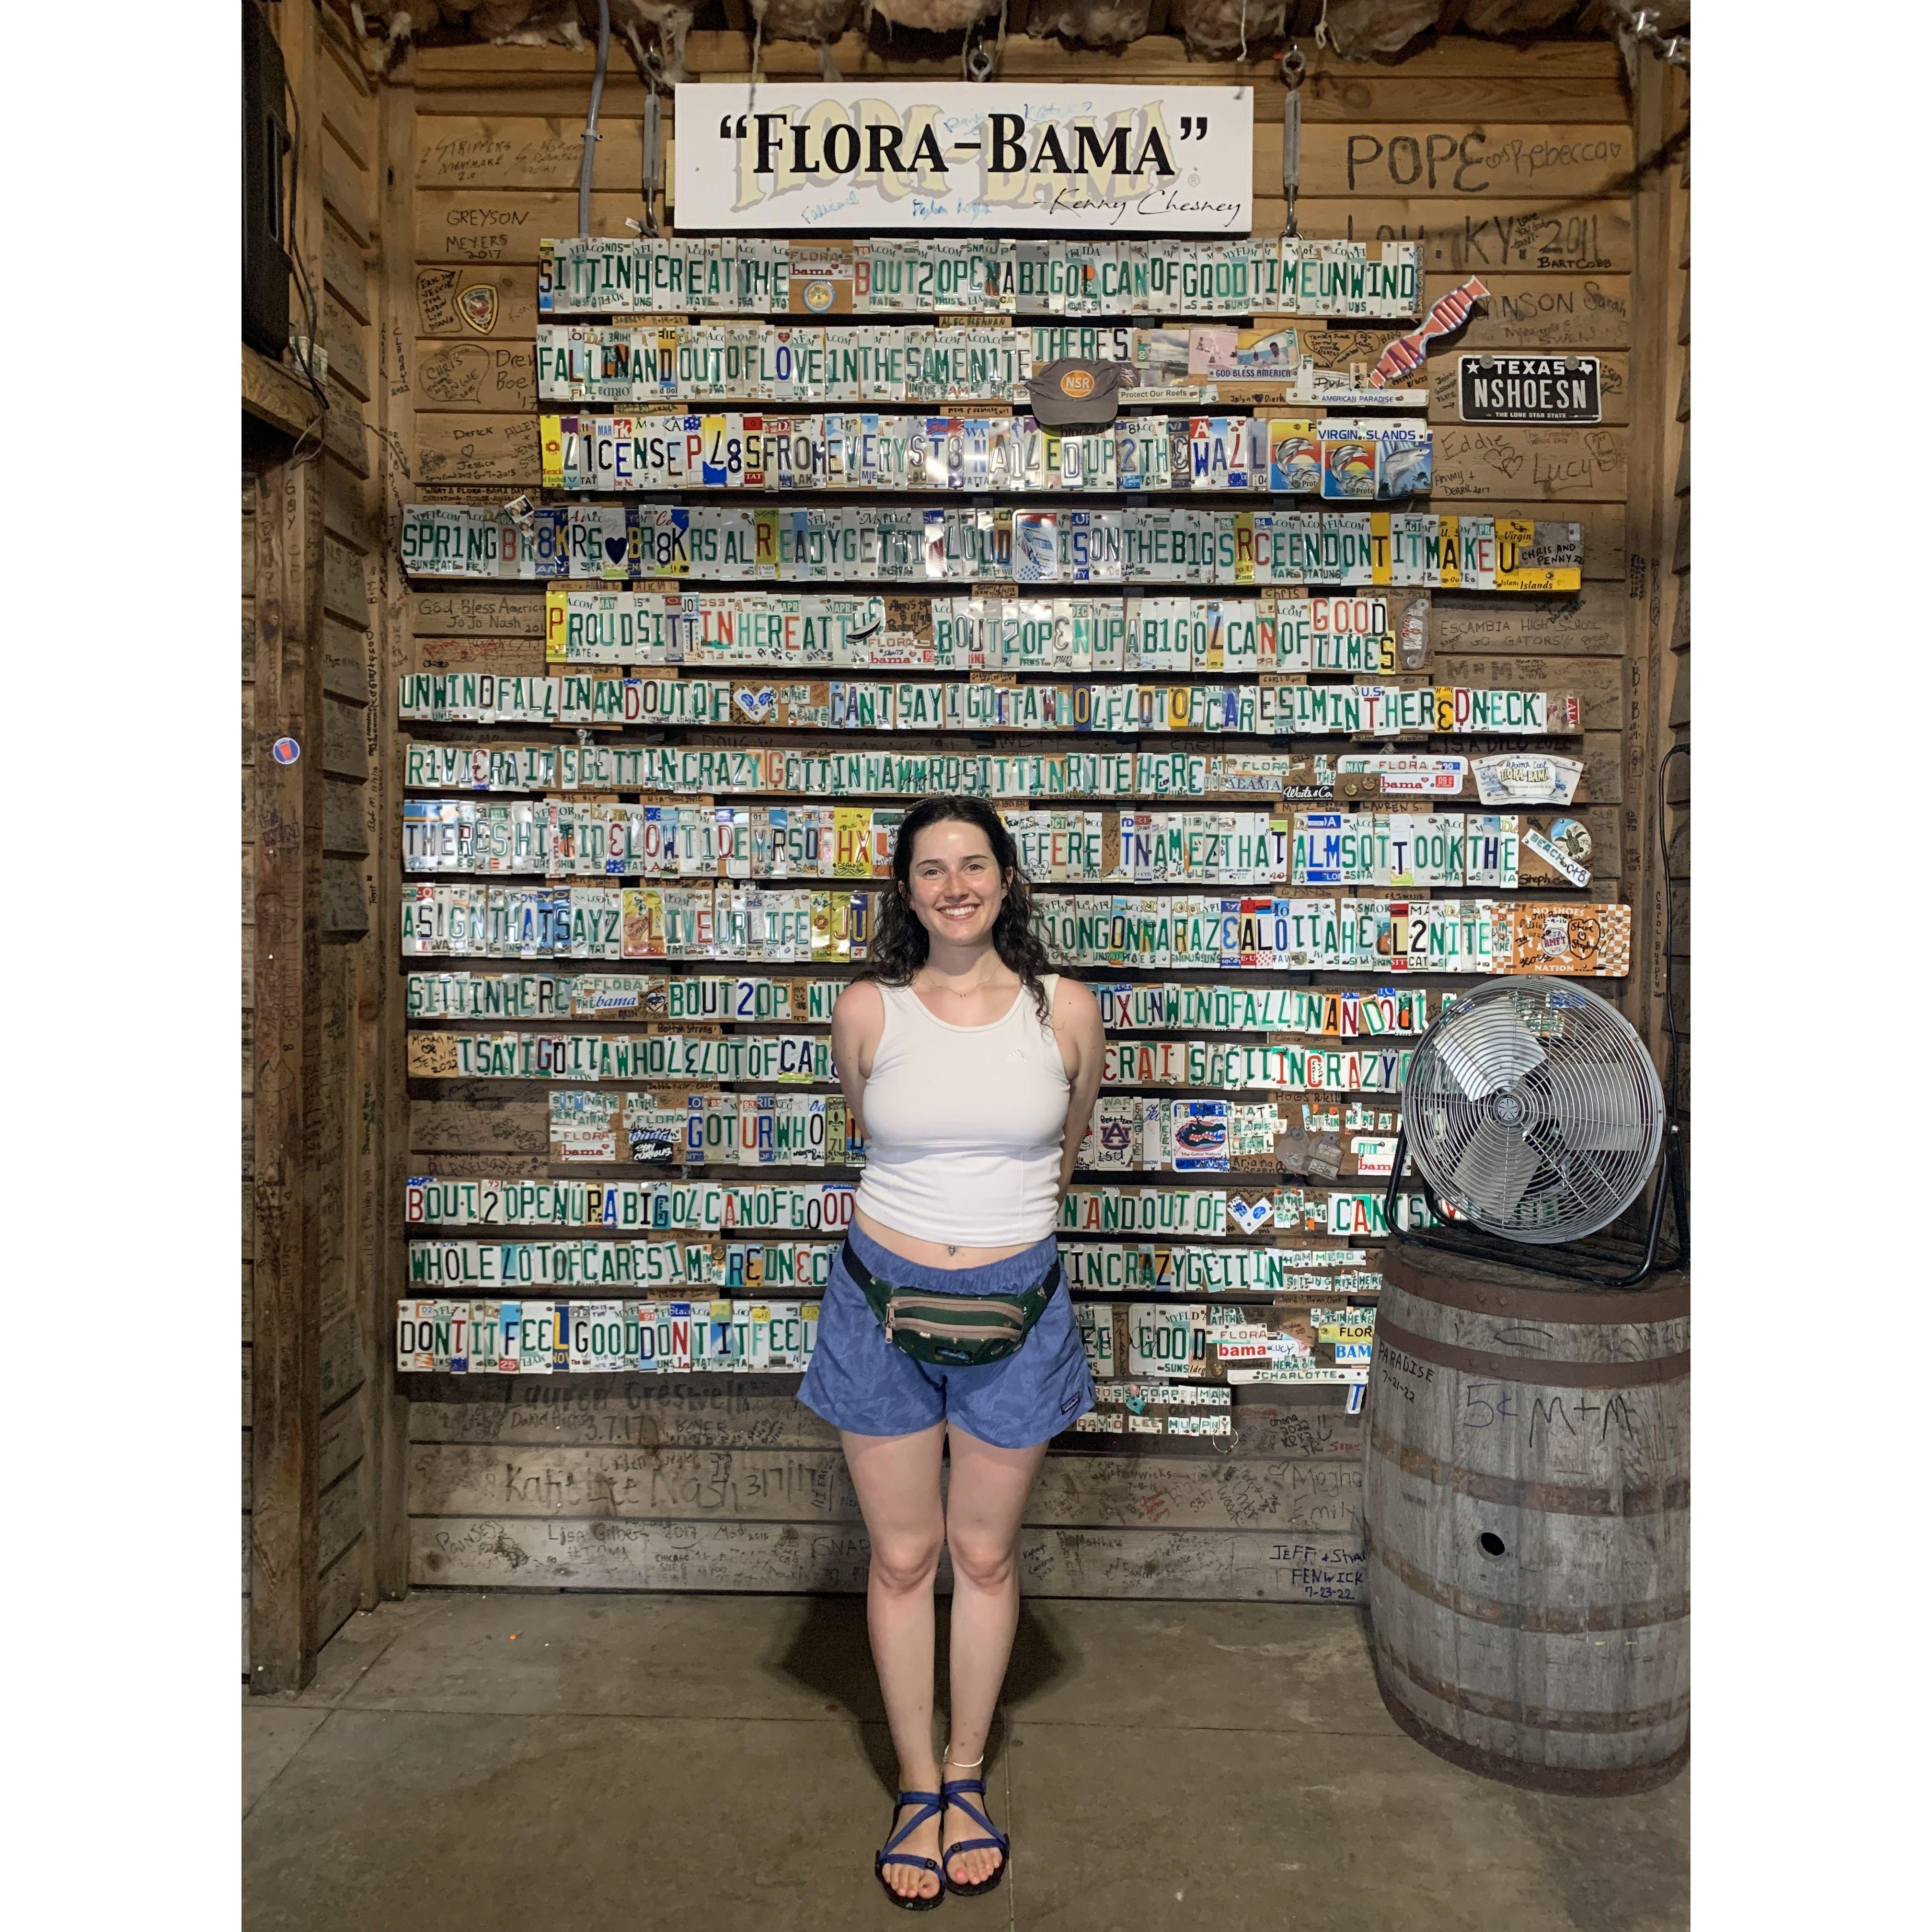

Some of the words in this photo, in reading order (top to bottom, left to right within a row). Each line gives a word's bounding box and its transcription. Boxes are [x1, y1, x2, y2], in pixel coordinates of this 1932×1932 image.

[1347, 133, 1490, 192] POPE
[1138, 189, 1241, 226] Chesney
[446, 210, 529, 226] GREYSON
[446, 234, 508, 253] MEYERS
[465, 249, 502, 260] 2017
[790, 263, 834, 276] bama
[1216, 368, 1231, 378] GOD
[1233, 368, 1254, 378] BLESS
[1257, 368, 1291, 378] AMERICA
[1495, 360, 1566, 376] TEXAS
[1066, 377, 1090, 390] NSR
[1120, 390, 1148, 399] Protect
[1150, 389, 1165, 398] Our
[1166, 389, 1187, 397] Reefs
[1474, 378, 1587, 409] NSHOESN
[1318, 429, 1358, 440] VIRGIN
[1440, 431, 1511, 460] Eddie
[456, 459, 495, 471] Jessica
[1521, 545, 1553, 562] CHRIS
[1556, 543, 1576, 554] AND
[1537, 553, 1572, 565] PENNY
[1519, 579, 1553, 590] Islands
[417, 598, 453, 616] God
[460, 598, 496, 614] Bless
[498, 598, 546, 614] America
[782, 603, 799, 612] APR
[834, 604, 851, 614] APR
[487, 615, 522, 630] Nash
[1312, 598, 1386, 635] GOOD
[1440, 620, 1510, 636] ESCAMBIA
[1521, 618, 1549, 632] HIGH
[1555, 620, 1601, 632] SCHOOL
[870, 651, 911, 664] bama
[1312, 634, 1394, 670] TIMES
[1242, 761, 1288, 770] FLORA
[1346, 762, 1363, 772] MAY
[1379, 761, 1426, 770] FLORA
[1380, 775, 1423, 790] bama
[1282, 802, 1315, 813] MIZ
[1362, 801, 1405, 813] LAUREN
[1530, 834, 1565, 862] BEACH
[1533, 908, 1550, 916] NO
[1552, 907, 1585, 917] SHOES
[594, 979, 642, 990] FLORA
[595, 995, 637, 1007] bama
[1276, 1092, 1309, 1102] HOGS
[637, 1114, 684, 1124] FLORA
[564, 1130, 610, 1140] FLORA
[1162, 1103, 1171, 1157] GREEN
[562, 1144, 604, 1156] bama
[730, 1247, 835, 1285] REDNEC
[1220, 1330, 1267, 1339] FLORA
[1218, 1343, 1267, 1357] bama
[1377, 1343, 1436, 1385] PARADISE
[1261, 1370, 1337, 1380] CHARLOTTE
[1078, 1417, 1123, 1429] DAVID
[1132, 1418, 1160, 1428] LEE
[1169, 1416, 1230, 1432] MURPHY
[1269, 1544, 1316, 1561] JEFF
[1291, 1571, 1364, 1585] FENWICK
[1304, 1586, 1355, 1599] 7-23-22
